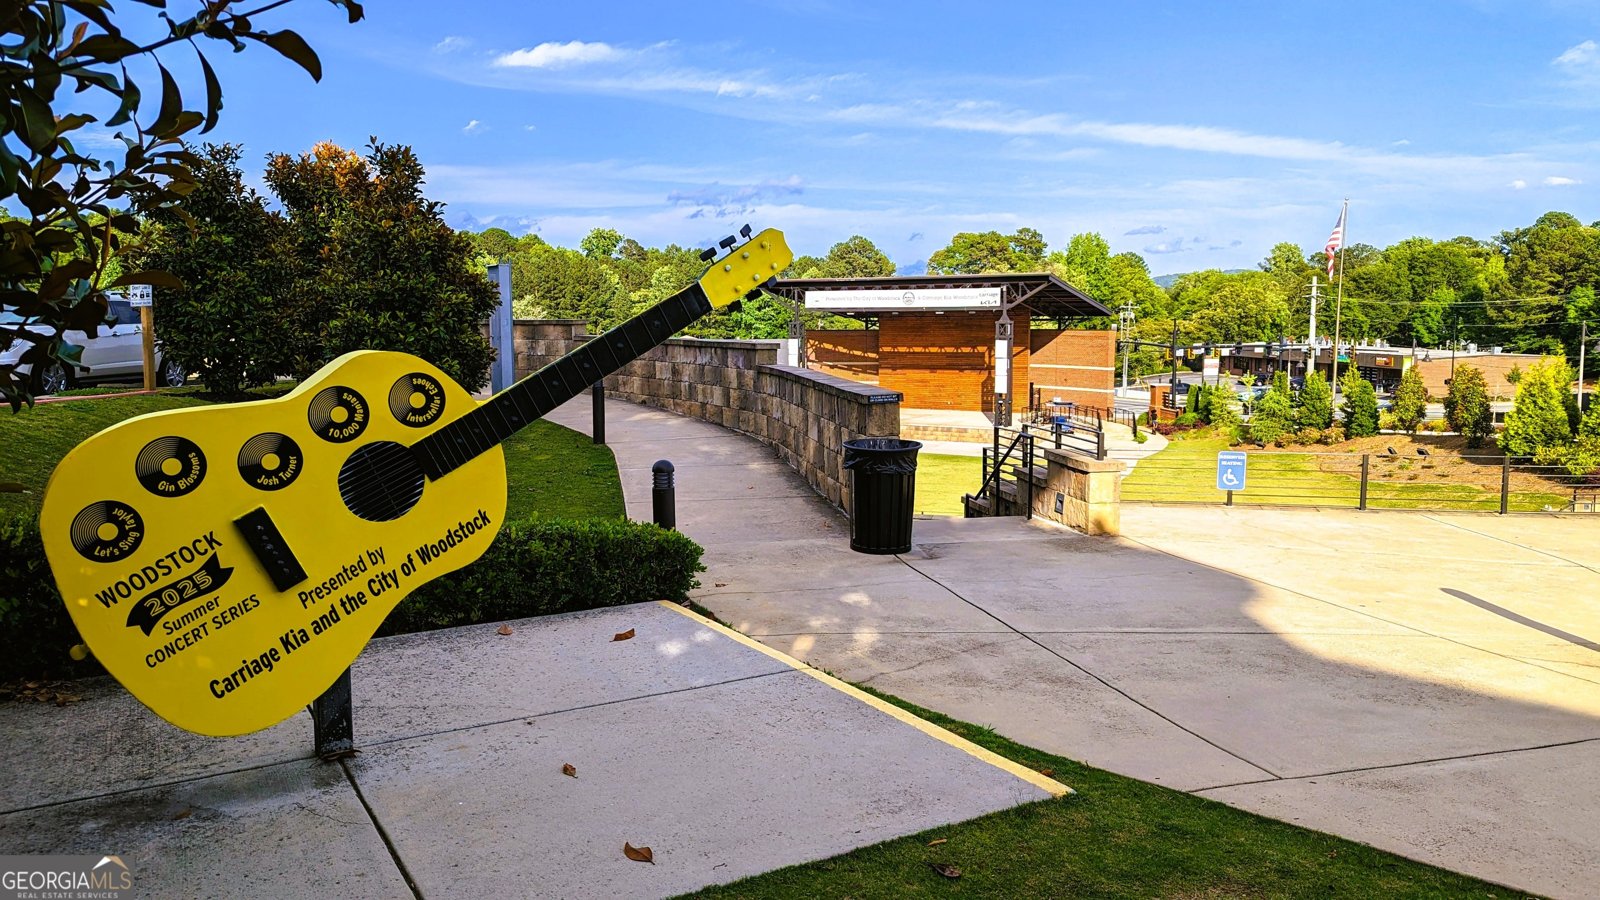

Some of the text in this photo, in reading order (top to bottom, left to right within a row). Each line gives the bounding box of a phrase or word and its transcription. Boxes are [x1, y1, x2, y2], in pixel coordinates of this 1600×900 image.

[328, 392, 365, 438] 10,000 Maniacs
[406, 377, 441, 423] Interstellar Echoes
[157, 452, 200, 492] Gin Blossoms
[257, 455, 298, 486] Josh Turner
[94, 507, 140, 557] Let's Sing Taylor
[94, 530, 223, 609] WOODSTOCK
[144, 569, 212, 617] 2025
[297, 546, 387, 610] Presented by
[162, 595, 220, 636] Summer
[209, 508, 492, 699] Carriage Kia and the City of Woodstock
[145, 593, 261, 669] CONCERT SERIES
